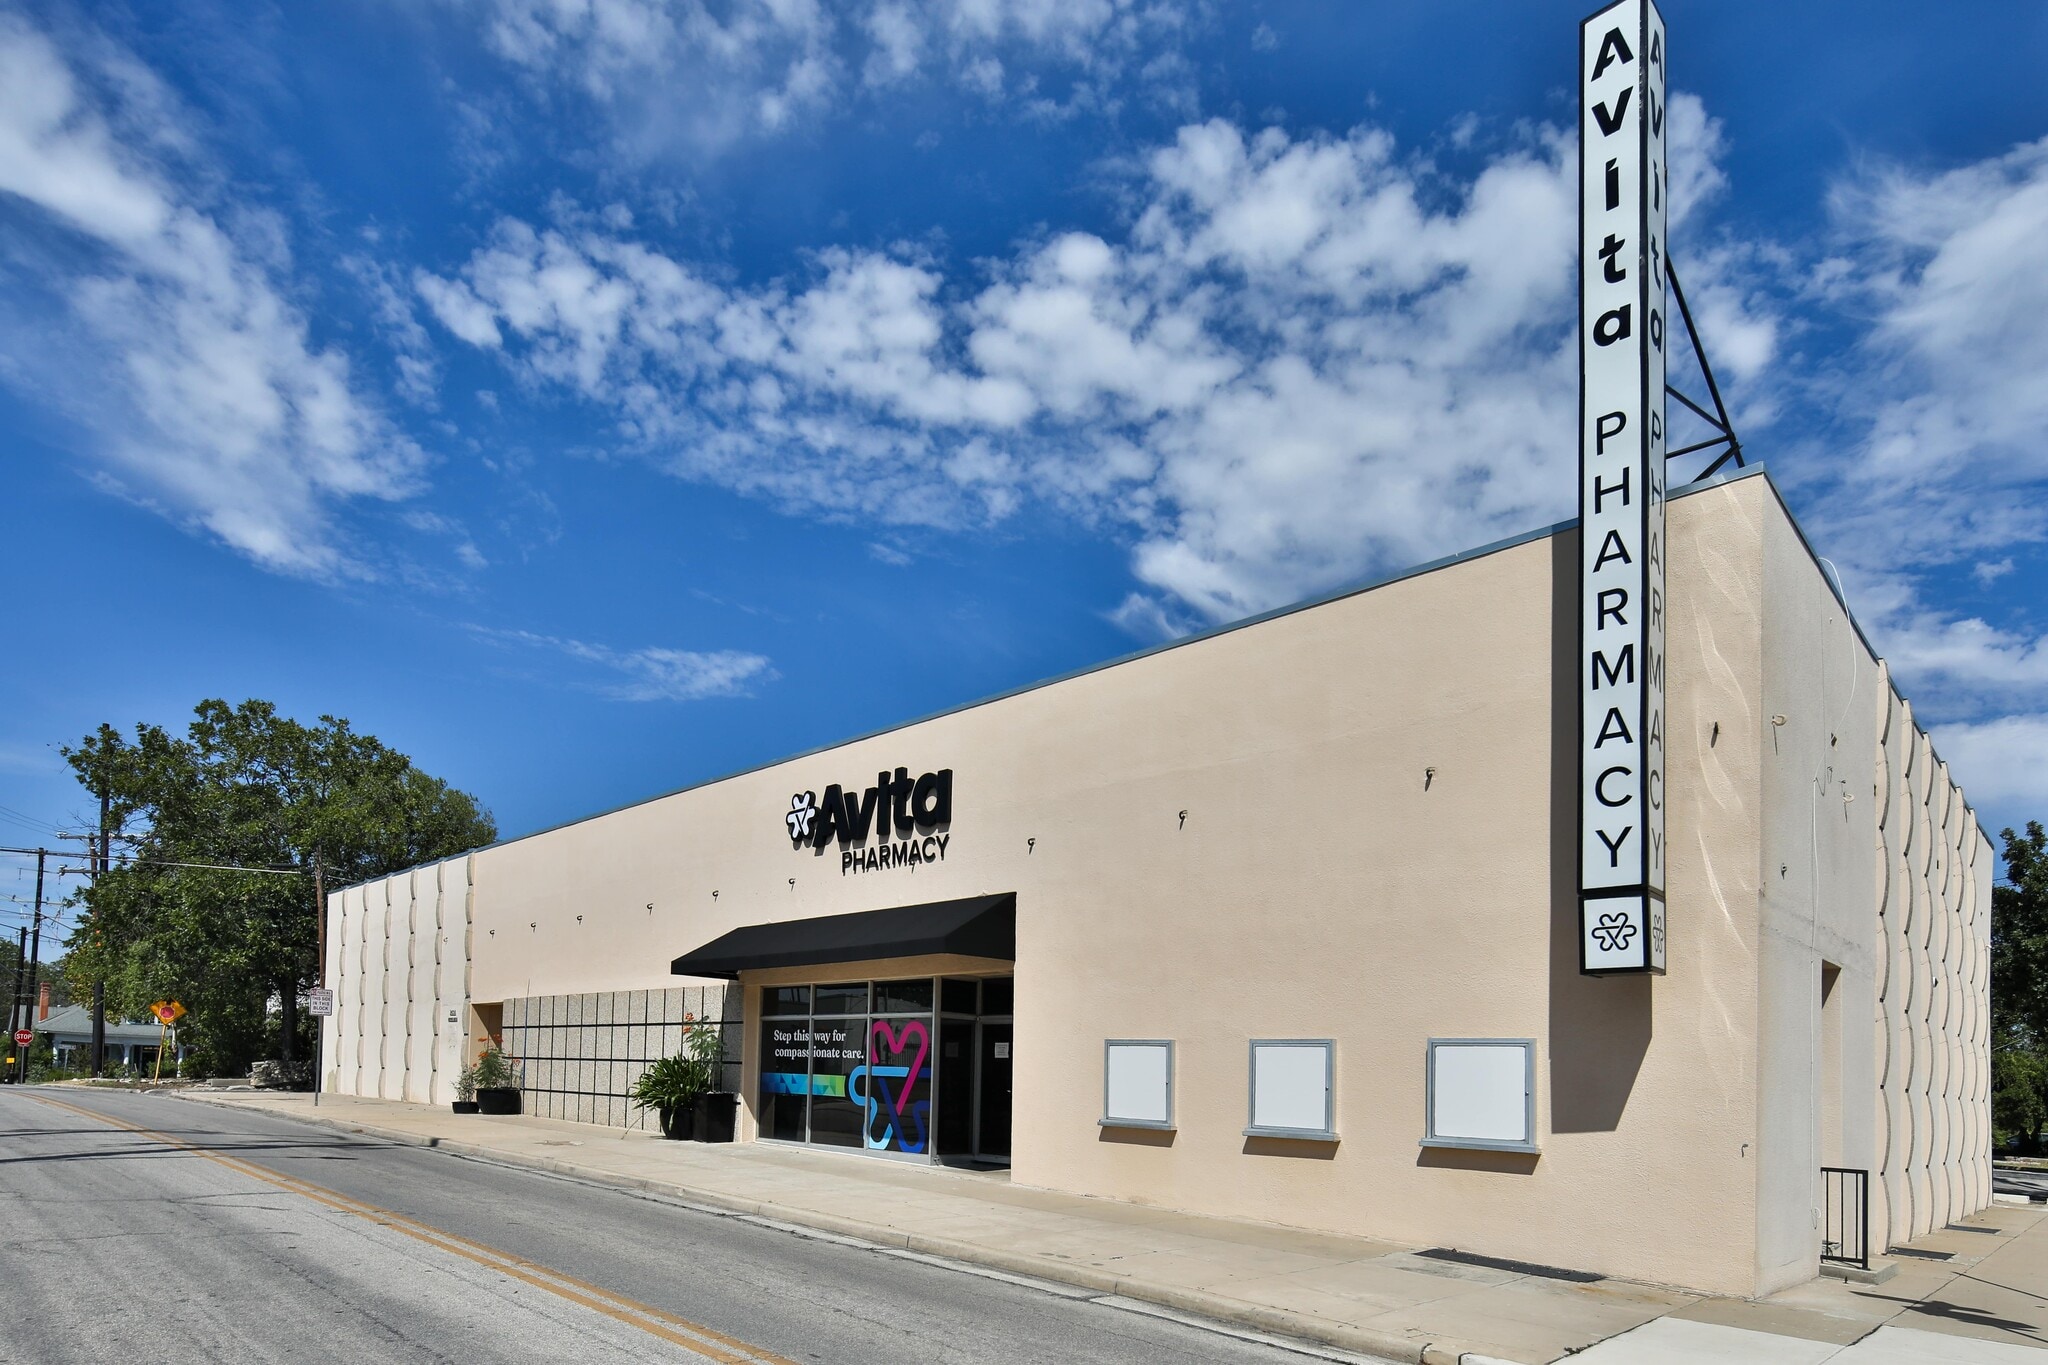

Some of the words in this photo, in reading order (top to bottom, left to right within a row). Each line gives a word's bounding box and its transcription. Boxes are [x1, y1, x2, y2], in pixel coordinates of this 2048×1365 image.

[1591, 27, 1634, 347] Avita
[1650, 29, 1663, 353] Avita
[1592, 411, 1634, 868] PHARMACY
[1649, 409, 1662, 869] PHARMACY
[812, 766, 953, 847] Avita
[842, 834, 950, 875] PHARMACY
[774, 1029, 791, 1043] Step
[793, 1029, 810, 1041] this
[814, 1032, 831, 1043] way
[832, 1029, 846, 1041] for
[842, 1049, 864, 1059] care.
